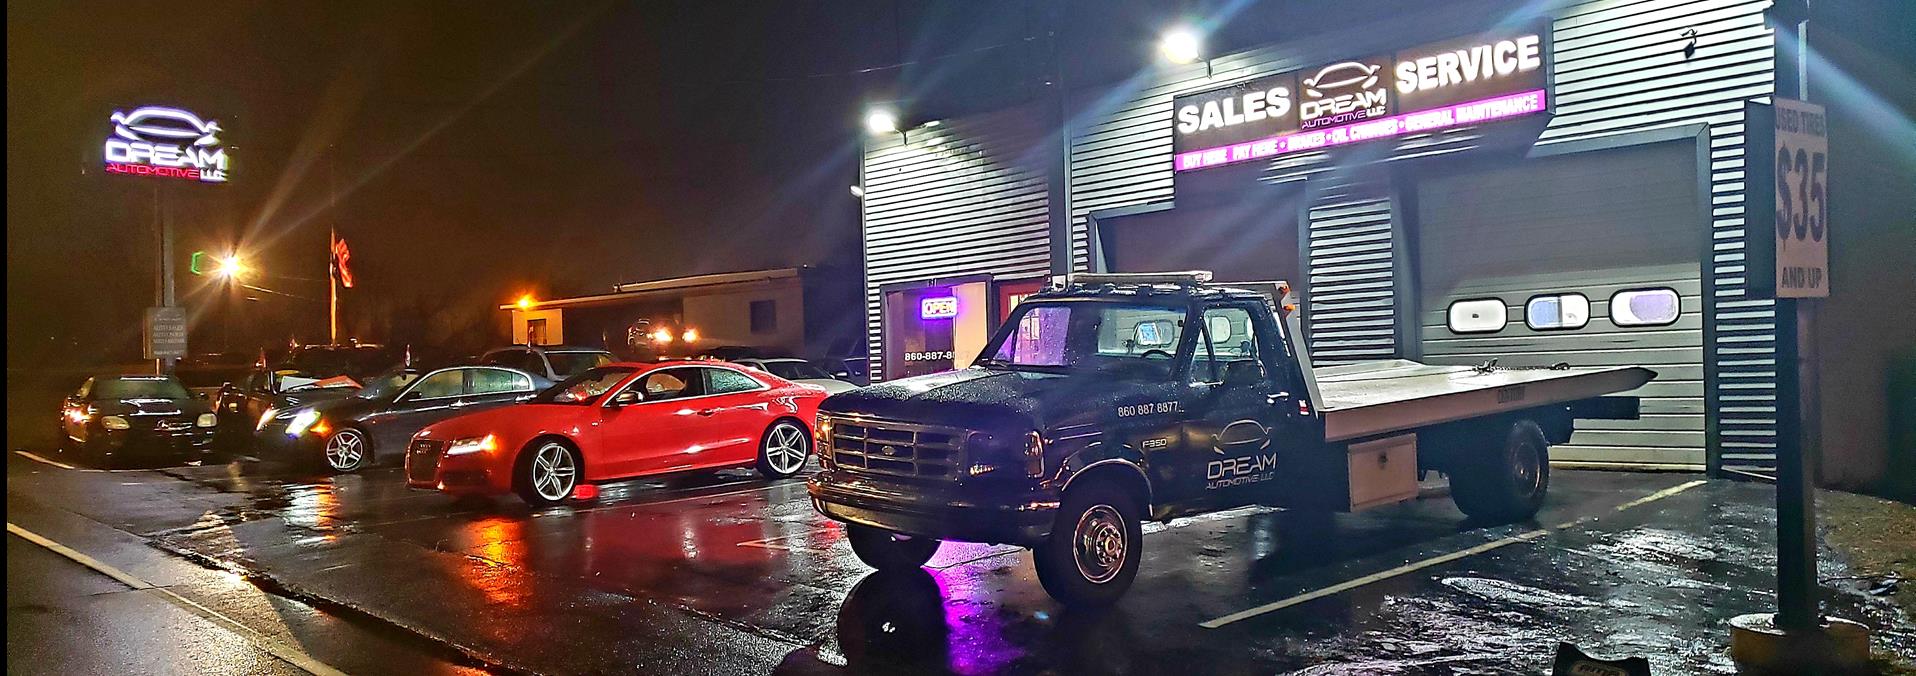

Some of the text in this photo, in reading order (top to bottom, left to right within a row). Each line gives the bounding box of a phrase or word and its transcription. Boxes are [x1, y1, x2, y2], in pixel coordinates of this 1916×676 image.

[1396, 35, 1541, 94] SERVICE
[1178, 86, 1291, 134] SALES
[1300, 88, 1387, 120] DREAM
[1302, 105, 1386, 130] AUTOMOTIVE LLC
[1456, 94, 1538, 123] MAINTENANCE
[1776, 107, 1826, 138] USED TIRES
[105, 139, 225, 170] DREAM
[106, 164, 228, 182] AUTOMOTIVE LLC
[1776, 142, 1826, 250] $35
[1781, 266, 1823, 289] AND UP
[924, 300, 955, 315] OPEN
[904, 351, 955, 361] 860-887-8
[1117, 401, 1178, 418] 860 887 8877
[1207, 452, 1277, 480] DREAM
[1205, 471, 1275, 490] AUTOMOTIVE LLC
